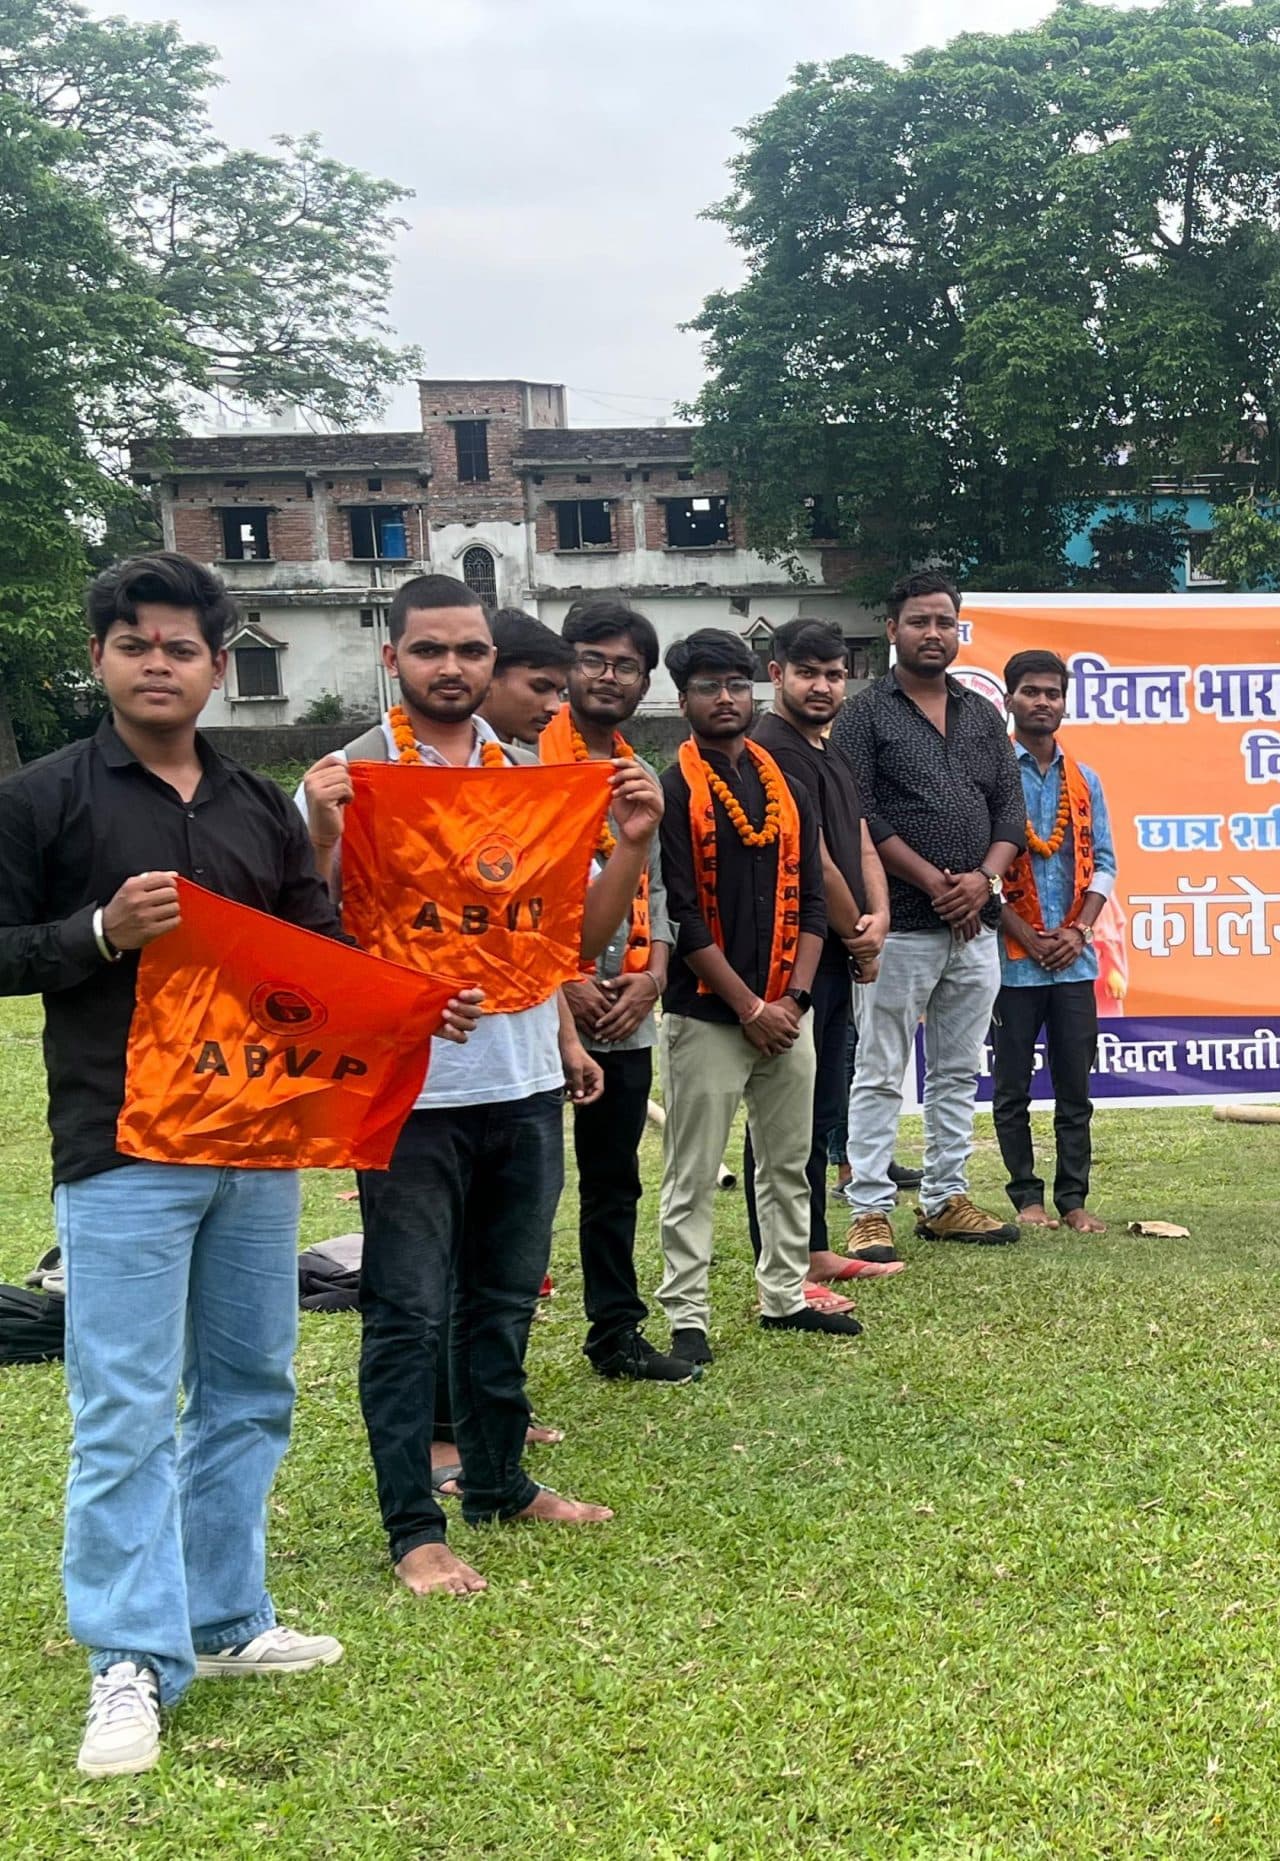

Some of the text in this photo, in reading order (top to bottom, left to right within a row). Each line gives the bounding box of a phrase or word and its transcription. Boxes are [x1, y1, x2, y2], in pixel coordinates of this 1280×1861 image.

[1064, 657, 1186, 720] खिल
[1137, 817, 1221, 849] छात्र
[411, 896, 544, 935] ABVP
[193, 1040, 369, 1081] ABVP
[1090, 1030, 1178, 1074] खिल
